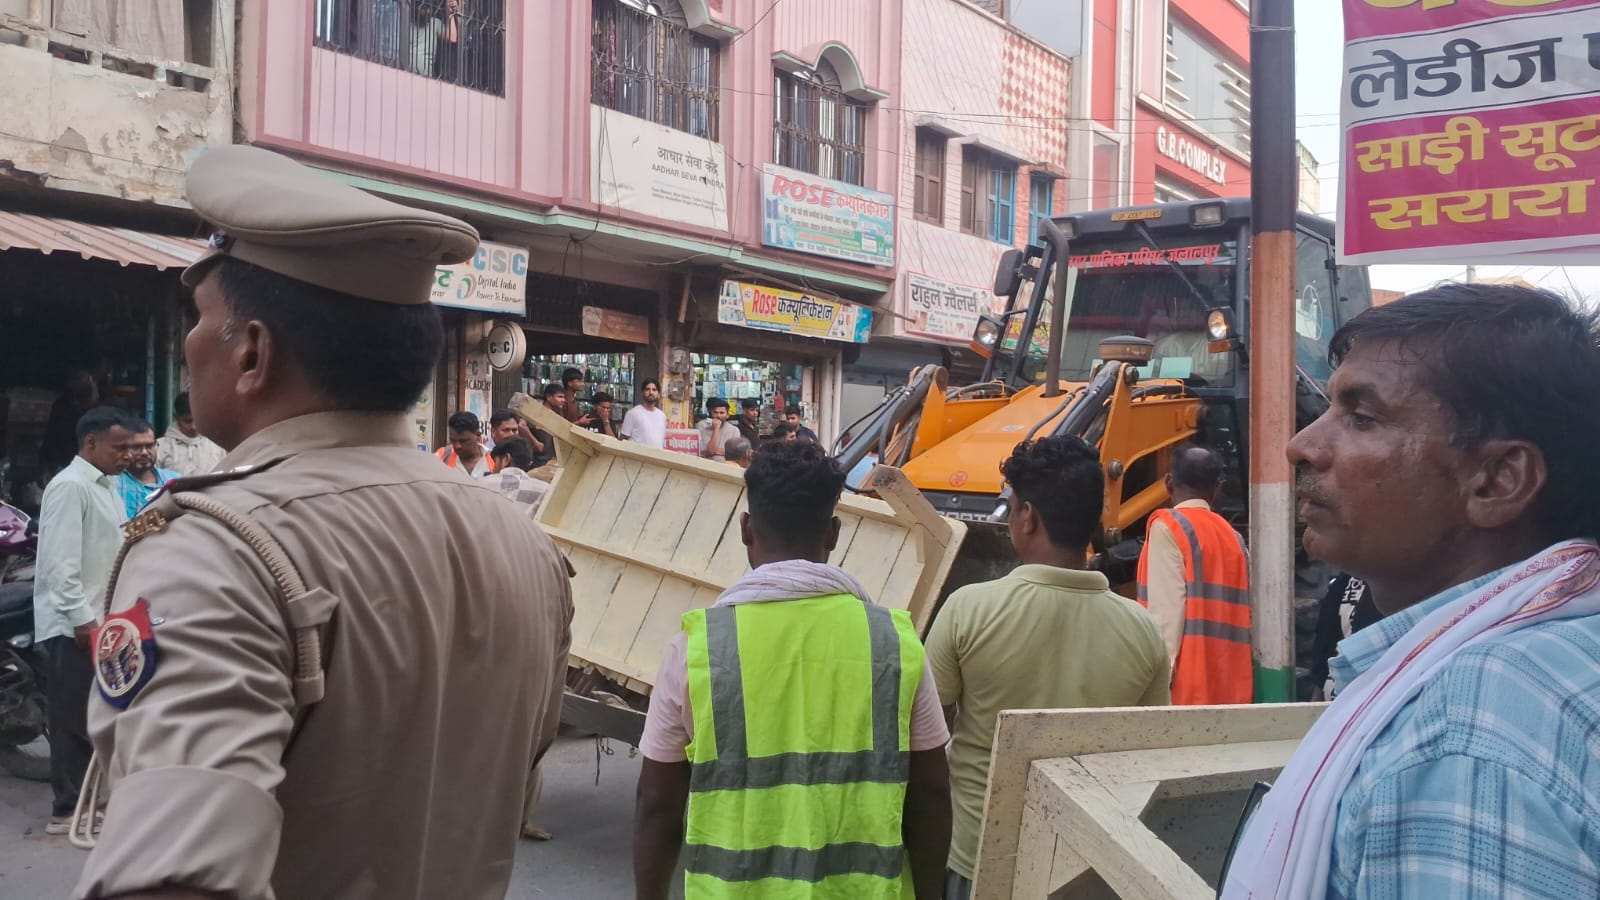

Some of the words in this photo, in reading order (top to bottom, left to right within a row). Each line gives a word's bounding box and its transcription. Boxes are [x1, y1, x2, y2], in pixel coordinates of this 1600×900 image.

[1349, 37, 1564, 109] लेडीज
[656, 146, 684, 166] आधार
[684, 151, 703, 170] सेवा
[1355, 116, 1490, 175] साड़ी
[651, 163, 681, 178] AADHAR
[680, 171, 699, 183] SEVA
[771, 175, 833, 208] ROSE
[1368, 179, 1595, 230] सरारा
[500, 279, 517, 291] India
[910, 283, 941, 309] राहुल
[751, 289, 777, 316] Rose
